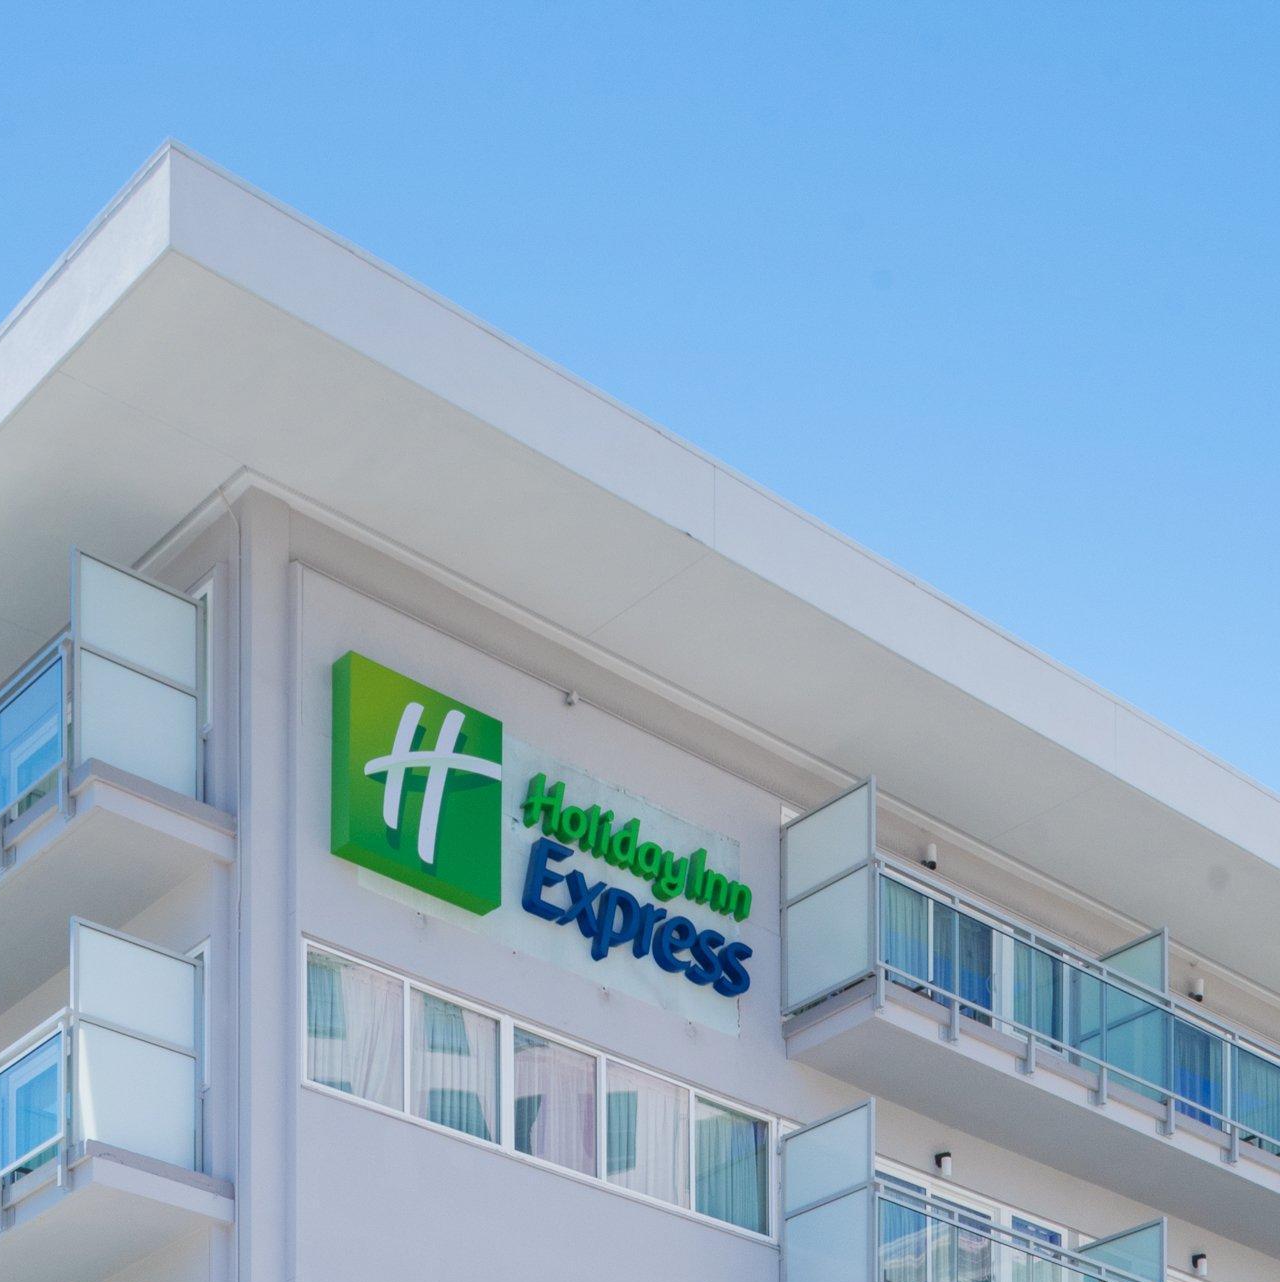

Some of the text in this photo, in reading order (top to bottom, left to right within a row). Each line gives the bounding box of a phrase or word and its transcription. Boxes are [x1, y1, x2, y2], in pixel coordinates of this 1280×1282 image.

[521, 772, 753, 922] Holiday Inn
[521, 836, 753, 998] Express
